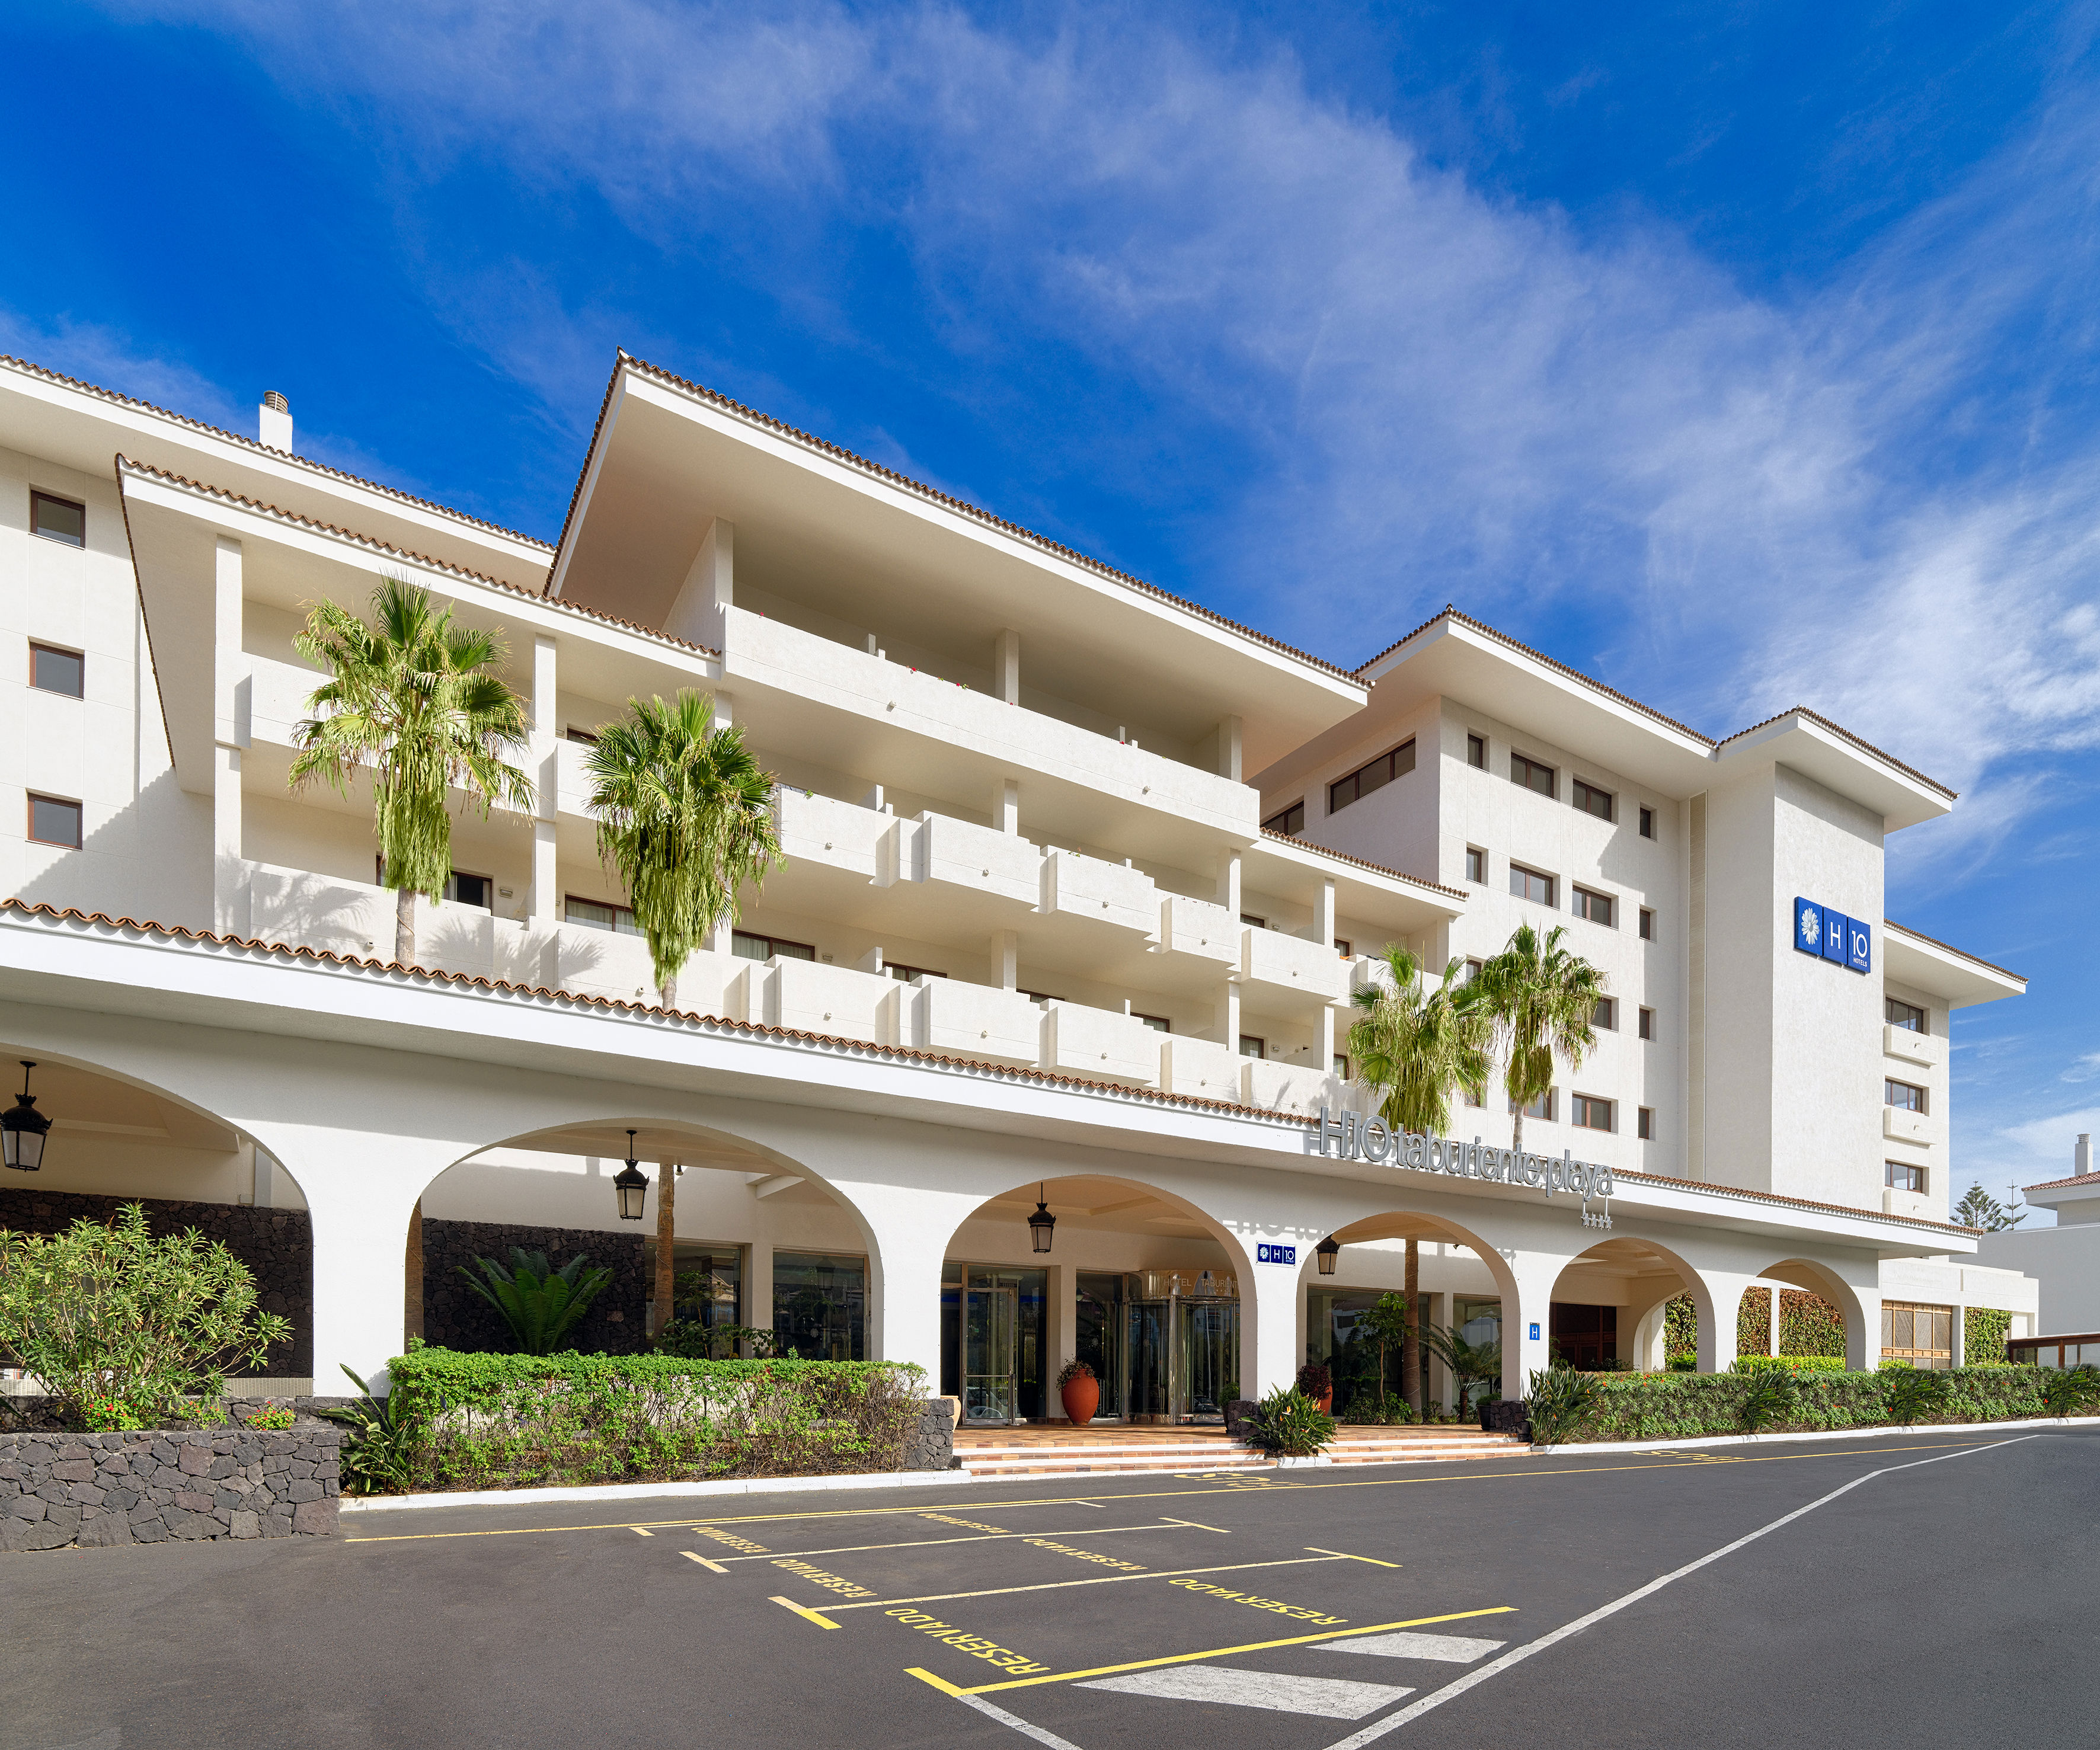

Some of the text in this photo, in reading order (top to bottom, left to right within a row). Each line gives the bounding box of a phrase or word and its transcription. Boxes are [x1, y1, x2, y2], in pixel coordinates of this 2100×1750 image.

[1830, 922, 1868, 958] H 10
[1853, 957, 1867, 967] HOTELS
[1319, 1106, 1614, 1202] H10 taburiente playa
[1164, 1278, 1192, 1287] HOTEL
[1532, 1327, 1538, 1339] H
[917, 1513, 1013, 1534] RESERVADO
[691, 1527, 772, 1553] RESERVADO
[1022, 1538, 1148, 1570] RESERVADO
[771, 1559, 877, 1598] RESERVADO
[1168, 1579, 1348, 1625] RESERVADO
[885, 1608, 1051, 1675] RESERVADO
